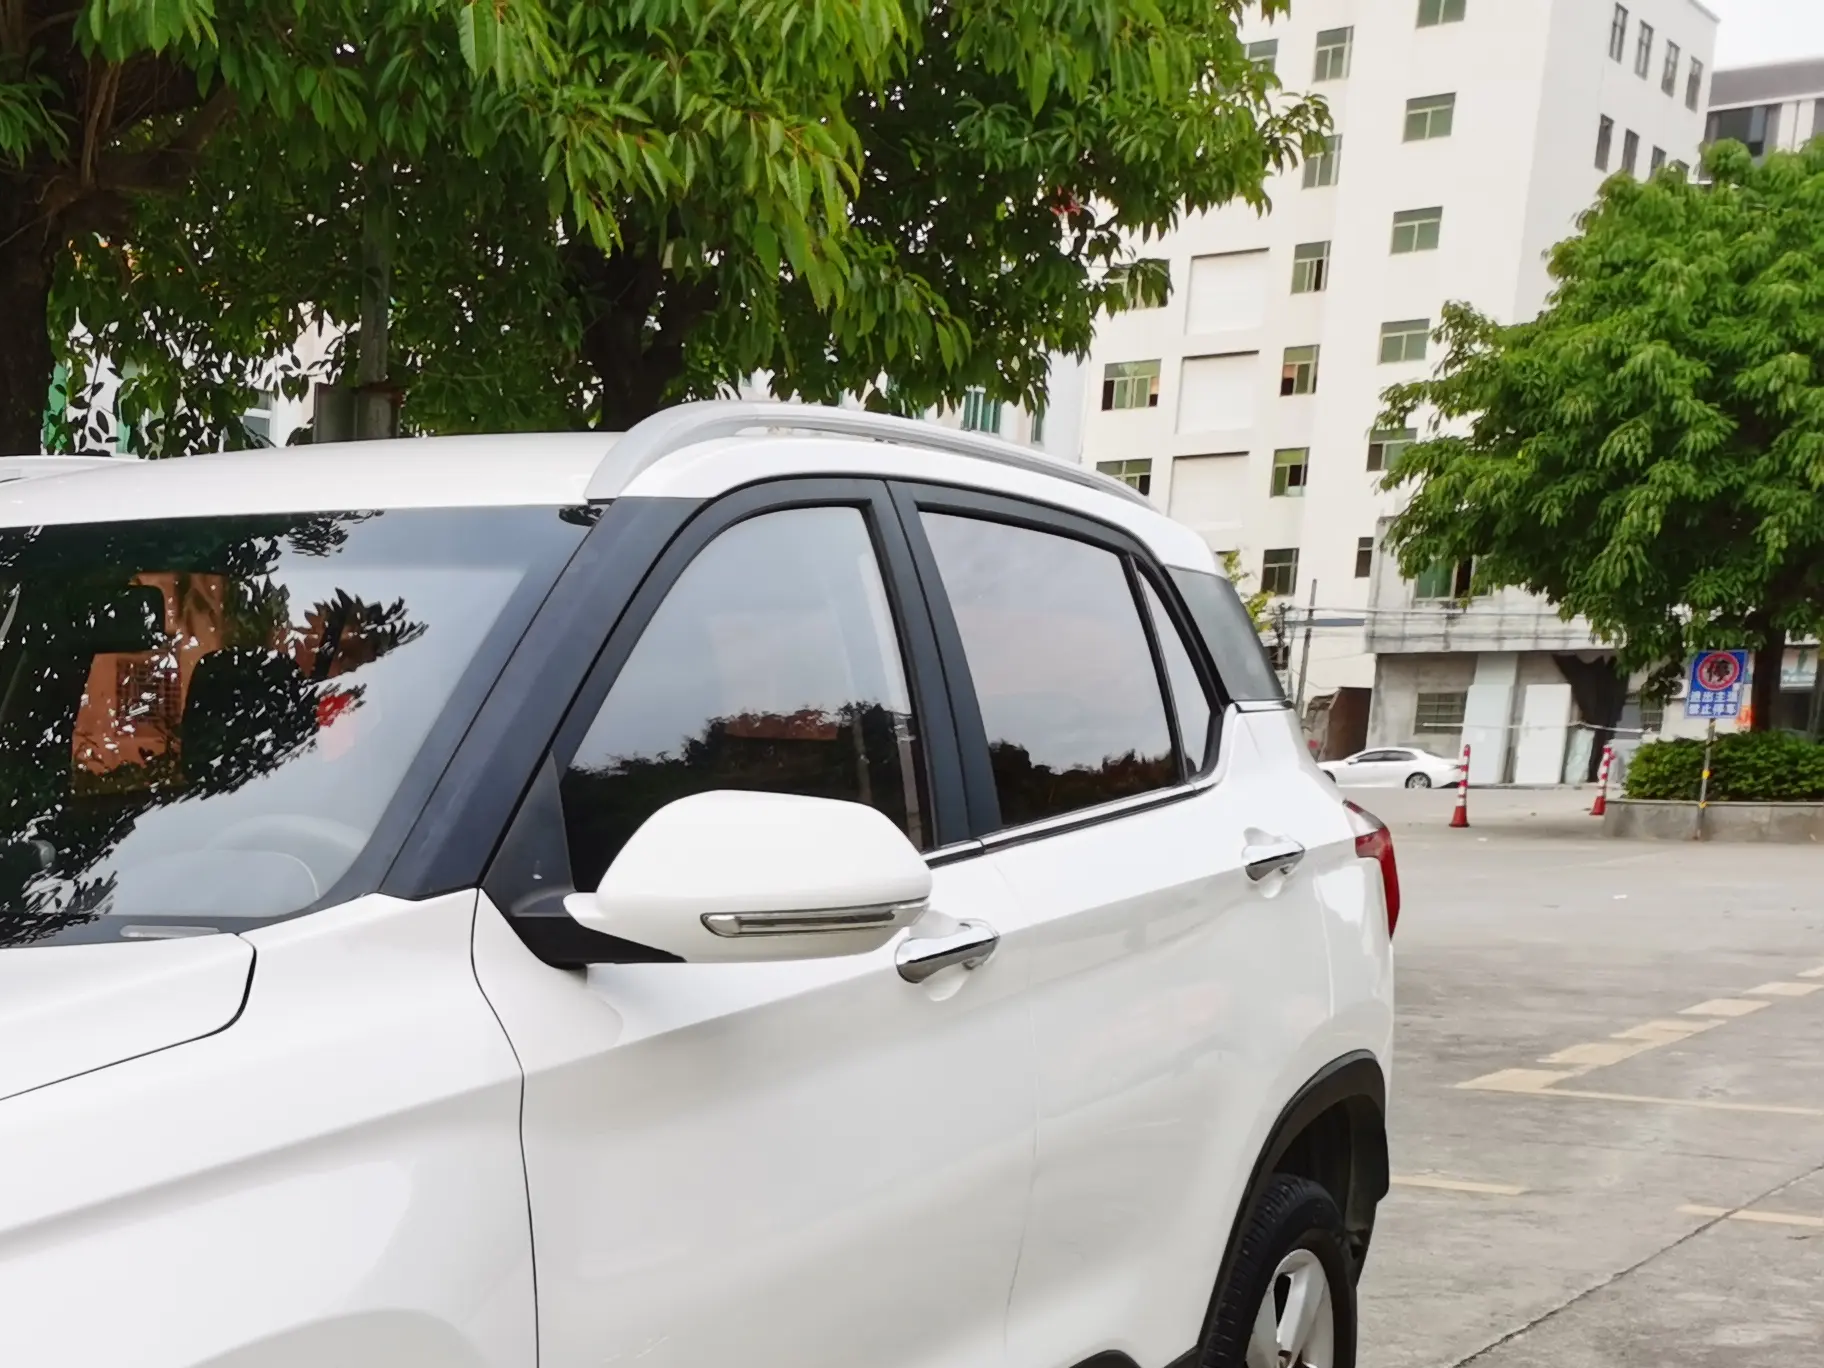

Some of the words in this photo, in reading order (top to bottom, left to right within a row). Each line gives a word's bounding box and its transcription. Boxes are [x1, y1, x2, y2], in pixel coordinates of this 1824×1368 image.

[1706, 659, 1731, 683] 停
[1689, 703, 1736, 716] 禁止停车
